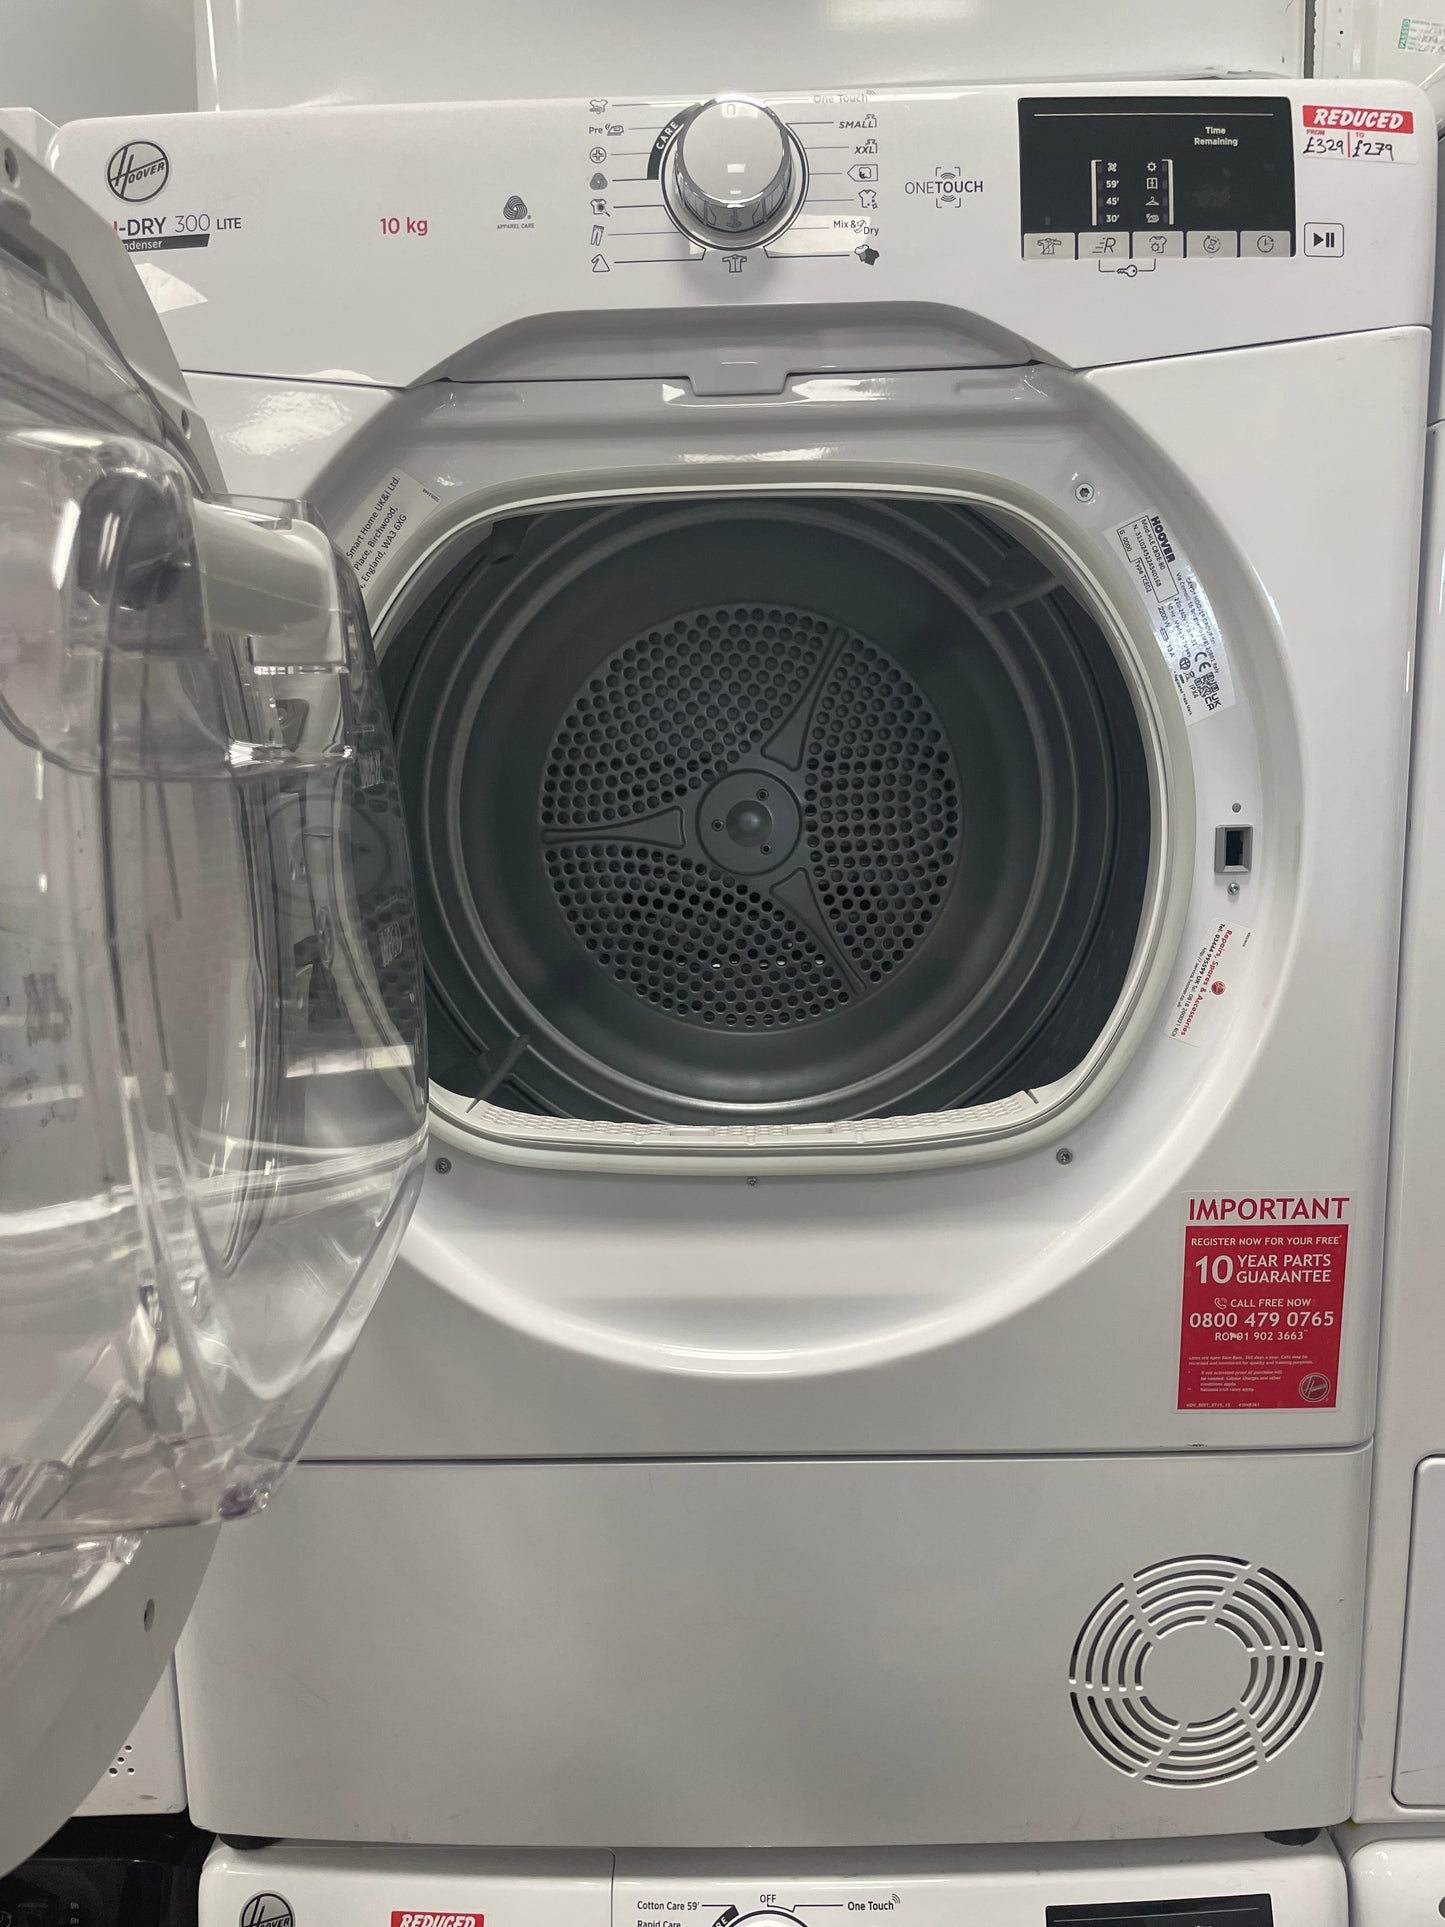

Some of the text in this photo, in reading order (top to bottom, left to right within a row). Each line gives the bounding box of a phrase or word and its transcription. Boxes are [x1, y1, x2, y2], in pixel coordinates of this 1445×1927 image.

[1313, 108, 1404, 129] REDUCED
[589, 126, 603, 134] Pre
[656, 121, 679, 150] CARE
[1205, 126, 1226, 134] Time
[1193, 137, 1239, 147] Remaining
[1303, 136, 1344, 154] £329
[854, 146, 875, 155] XXL
[1352, 140, 1394, 161] £279
[108, 142, 168, 201] HOOVER
[904, 181, 984, 195] ONETOUCH
[1106, 180, 1119, 189] 59'
[1106, 197, 1119, 206] 45'
[174, 213, 211, 233] 300
[216, 217, 242, 230] LITE
[1106, 214, 1119, 223] 30'
[380, 216, 428, 237] 10 kg
[833, 219, 880, 236] Mix & Dry
[123, 240, 163, 251] ndenser
[346, 477, 400, 558] Smart Home UK&I Ltd.
[354, 506, 397, 570] Place, Birchwood,
[1151, 516, 1175, 563] HOOVER
[362, 514, 407, 582] England, WA3 6XG
[1135, 560, 1143, 574] Type
[1157, 606, 1168, 621] 2200
[1217, 924, 1225, 933] Tel:
[1209, 934, 1220, 952] 03444
[1214, 930, 1232, 958] Repairs,
[1195, 976, 1202, 984] UK
[1203, 961, 1218, 985] Spares
[1181, 994, 1203, 1035] Accessories
[1189, 1197, 1350, 1220] IMPORTANT
[1191, 1237, 1236, 1246] REGISTER
[1239, 1237, 1262, 1246] NOW
[1264, 1237, 1283, 1246] FOR
[1286, 1236, 1313, 1245] YOUR
[1195, 1254, 1331, 1284] 10 YEAR PARTS
[1236, 1270, 1332, 1284] GUARANTEE
[1230, 1298, 1312, 1308] CALL FREE NOW
[1189, 1311, 1334, 1328] 0800 479 0765
[1253, 1331, 1273, 1340] 902
[637, 1901, 699, 1910] Cotton Care 59'
[759, 1894, 776, 1904] OFF
[848, 1901, 894, 1911] One Touch
